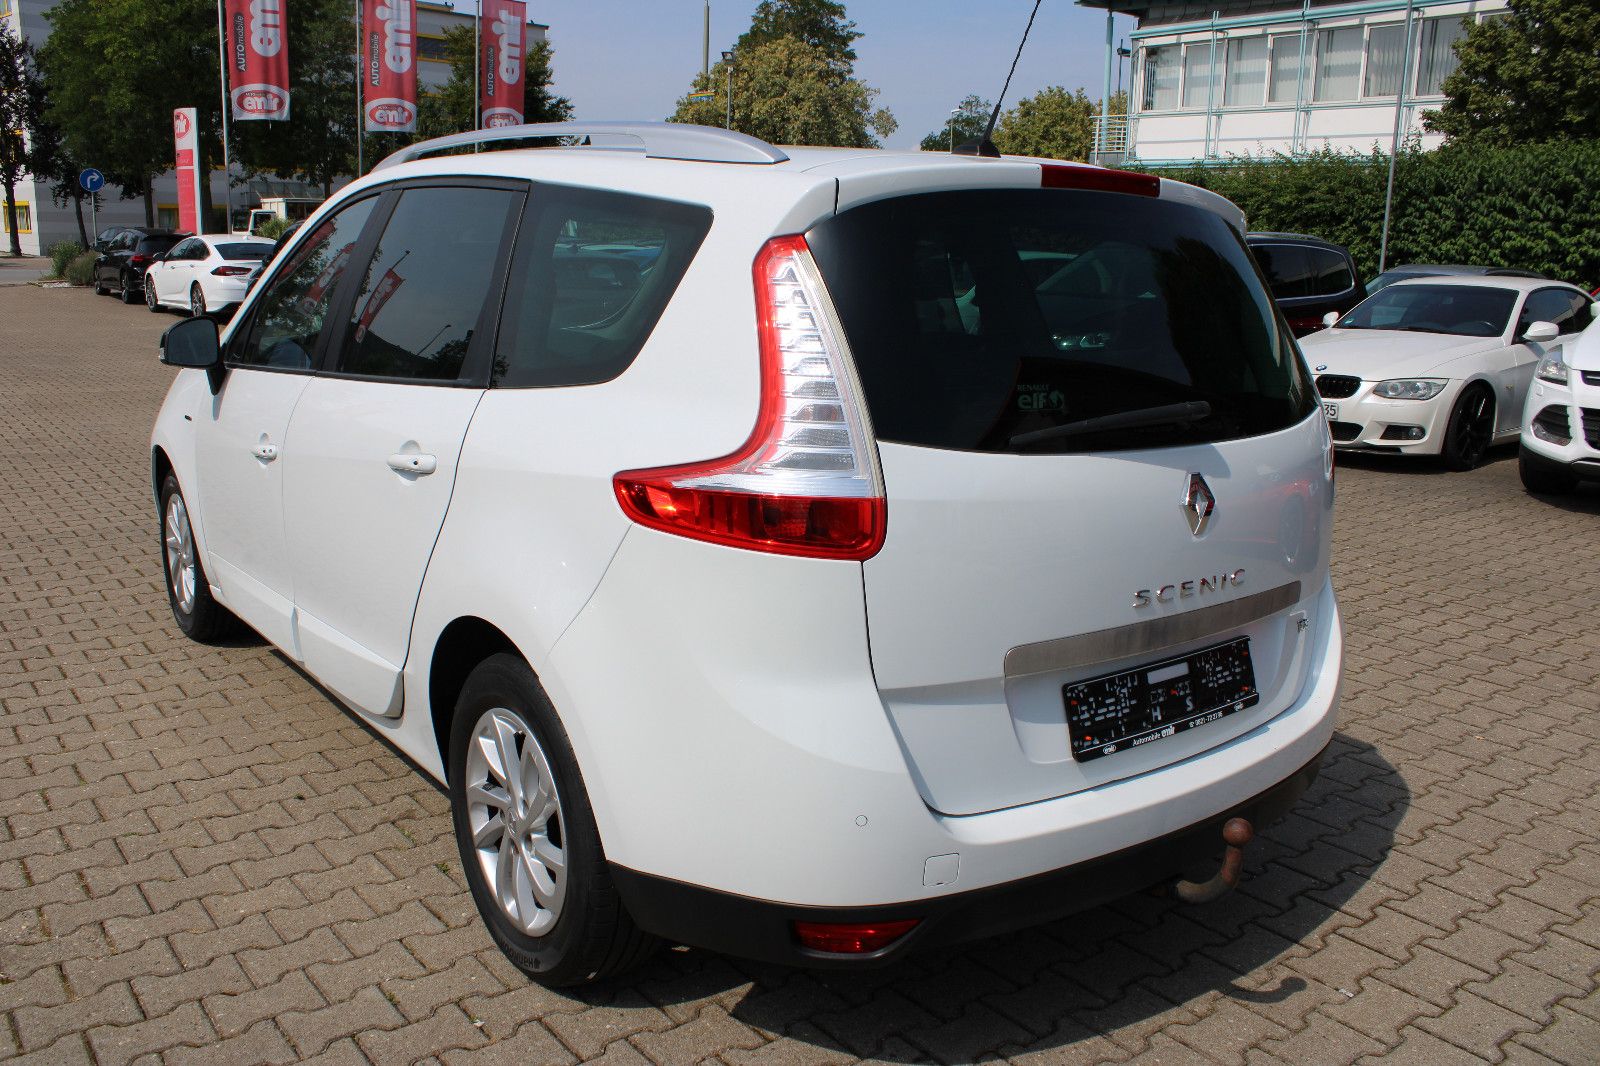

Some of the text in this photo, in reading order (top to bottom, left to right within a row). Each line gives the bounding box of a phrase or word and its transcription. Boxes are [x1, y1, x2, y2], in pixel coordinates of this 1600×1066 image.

[235, 15, 246, 72] AUTOmobile
[492, 9, 521, 85] emir
[371, 34, 379, 86] AUTOmobile
[243, 94, 280, 110] emir
[374, 107, 409, 124] emir
[1017, 392, 1047, 409] elf
[1133, 568, 1246, 608] SCENIC
[1132, 733, 1161, 747] Automobile
